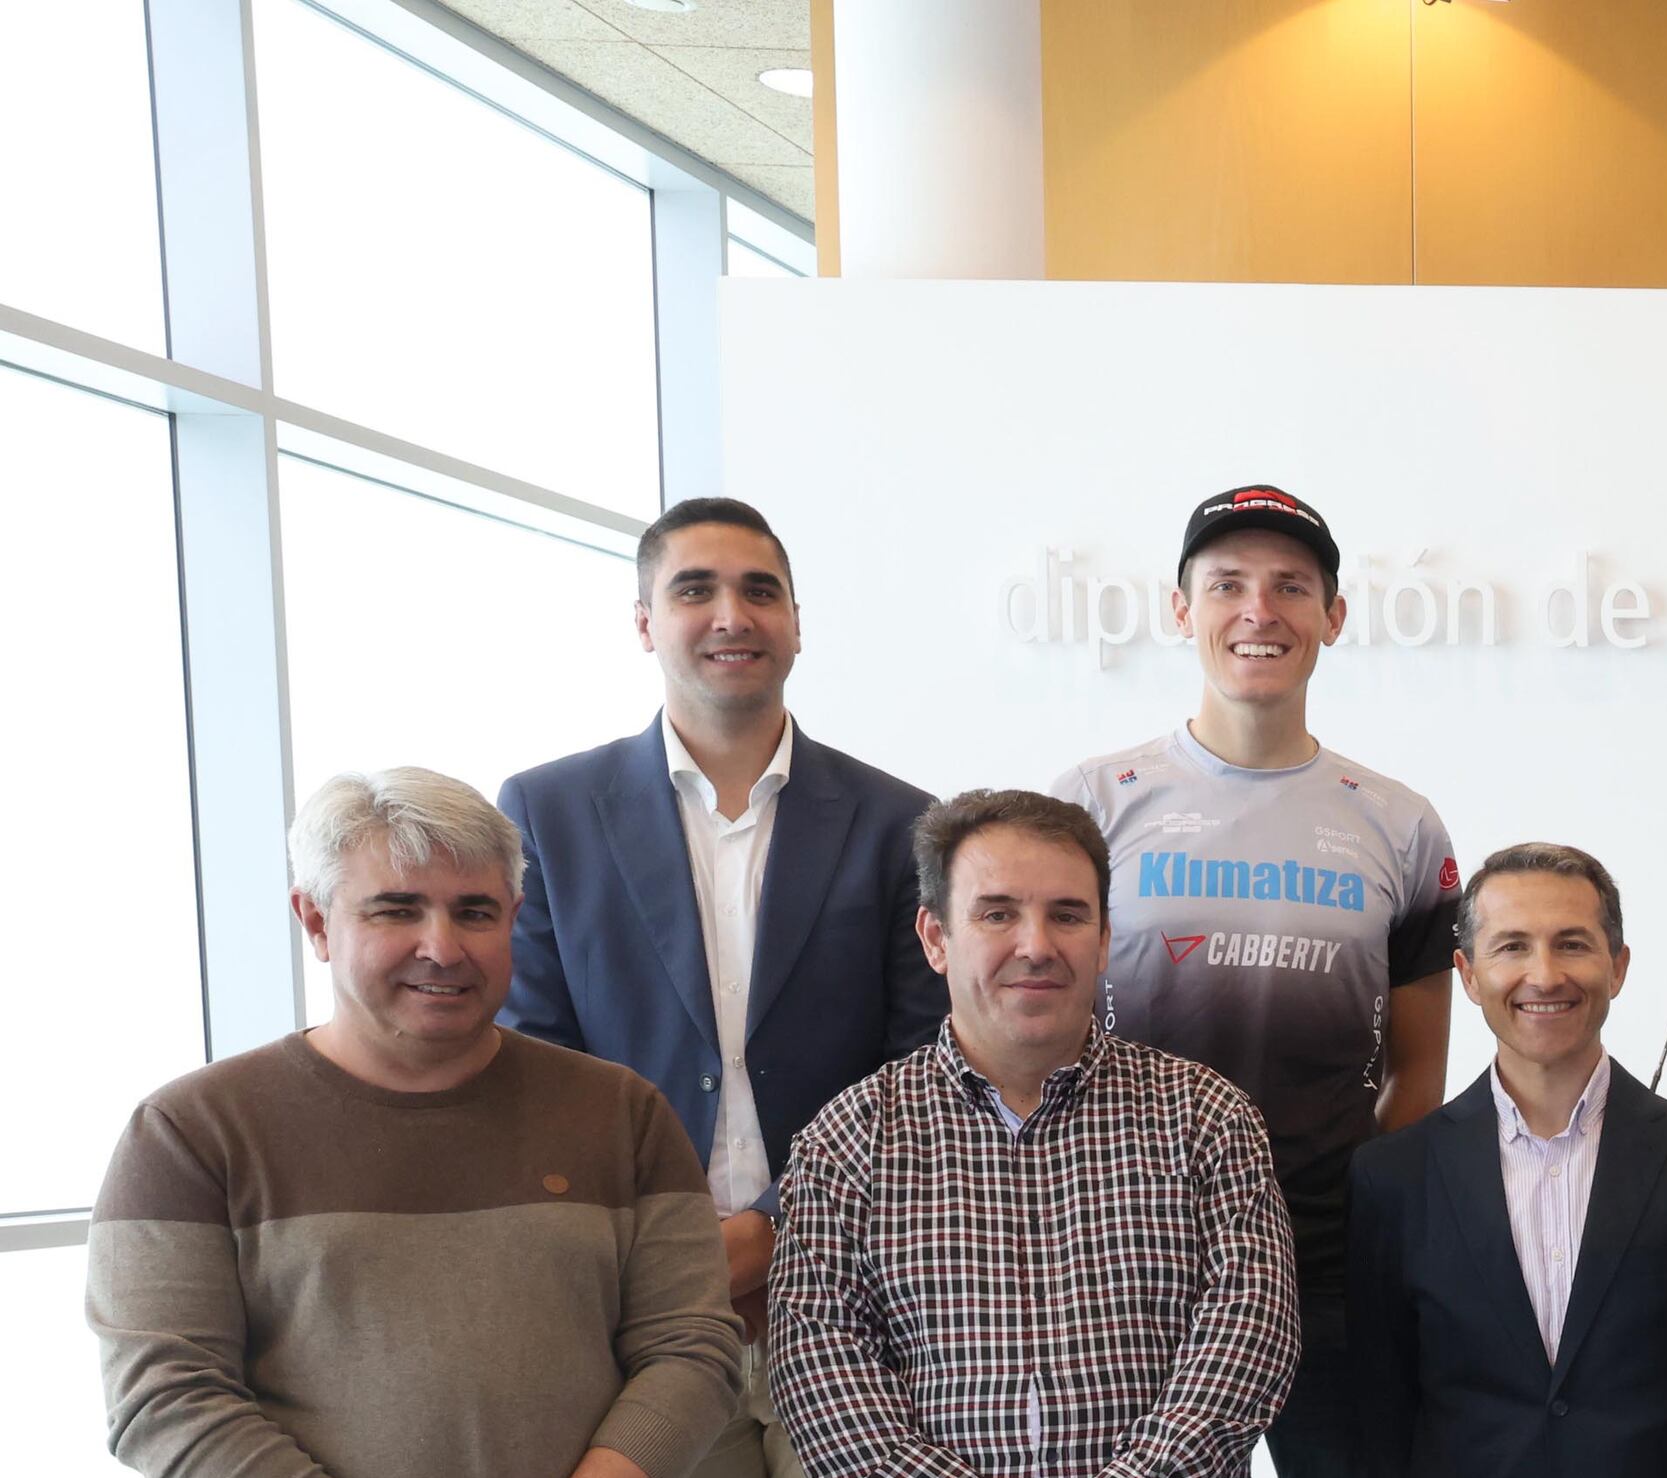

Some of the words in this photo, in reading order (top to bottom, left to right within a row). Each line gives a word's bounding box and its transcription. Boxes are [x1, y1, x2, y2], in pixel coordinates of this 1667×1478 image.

[1000, 546, 1500, 671] dipuión
[1542, 550, 1651, 648] de
[1207, 931, 1341, 974] CABBERTY
